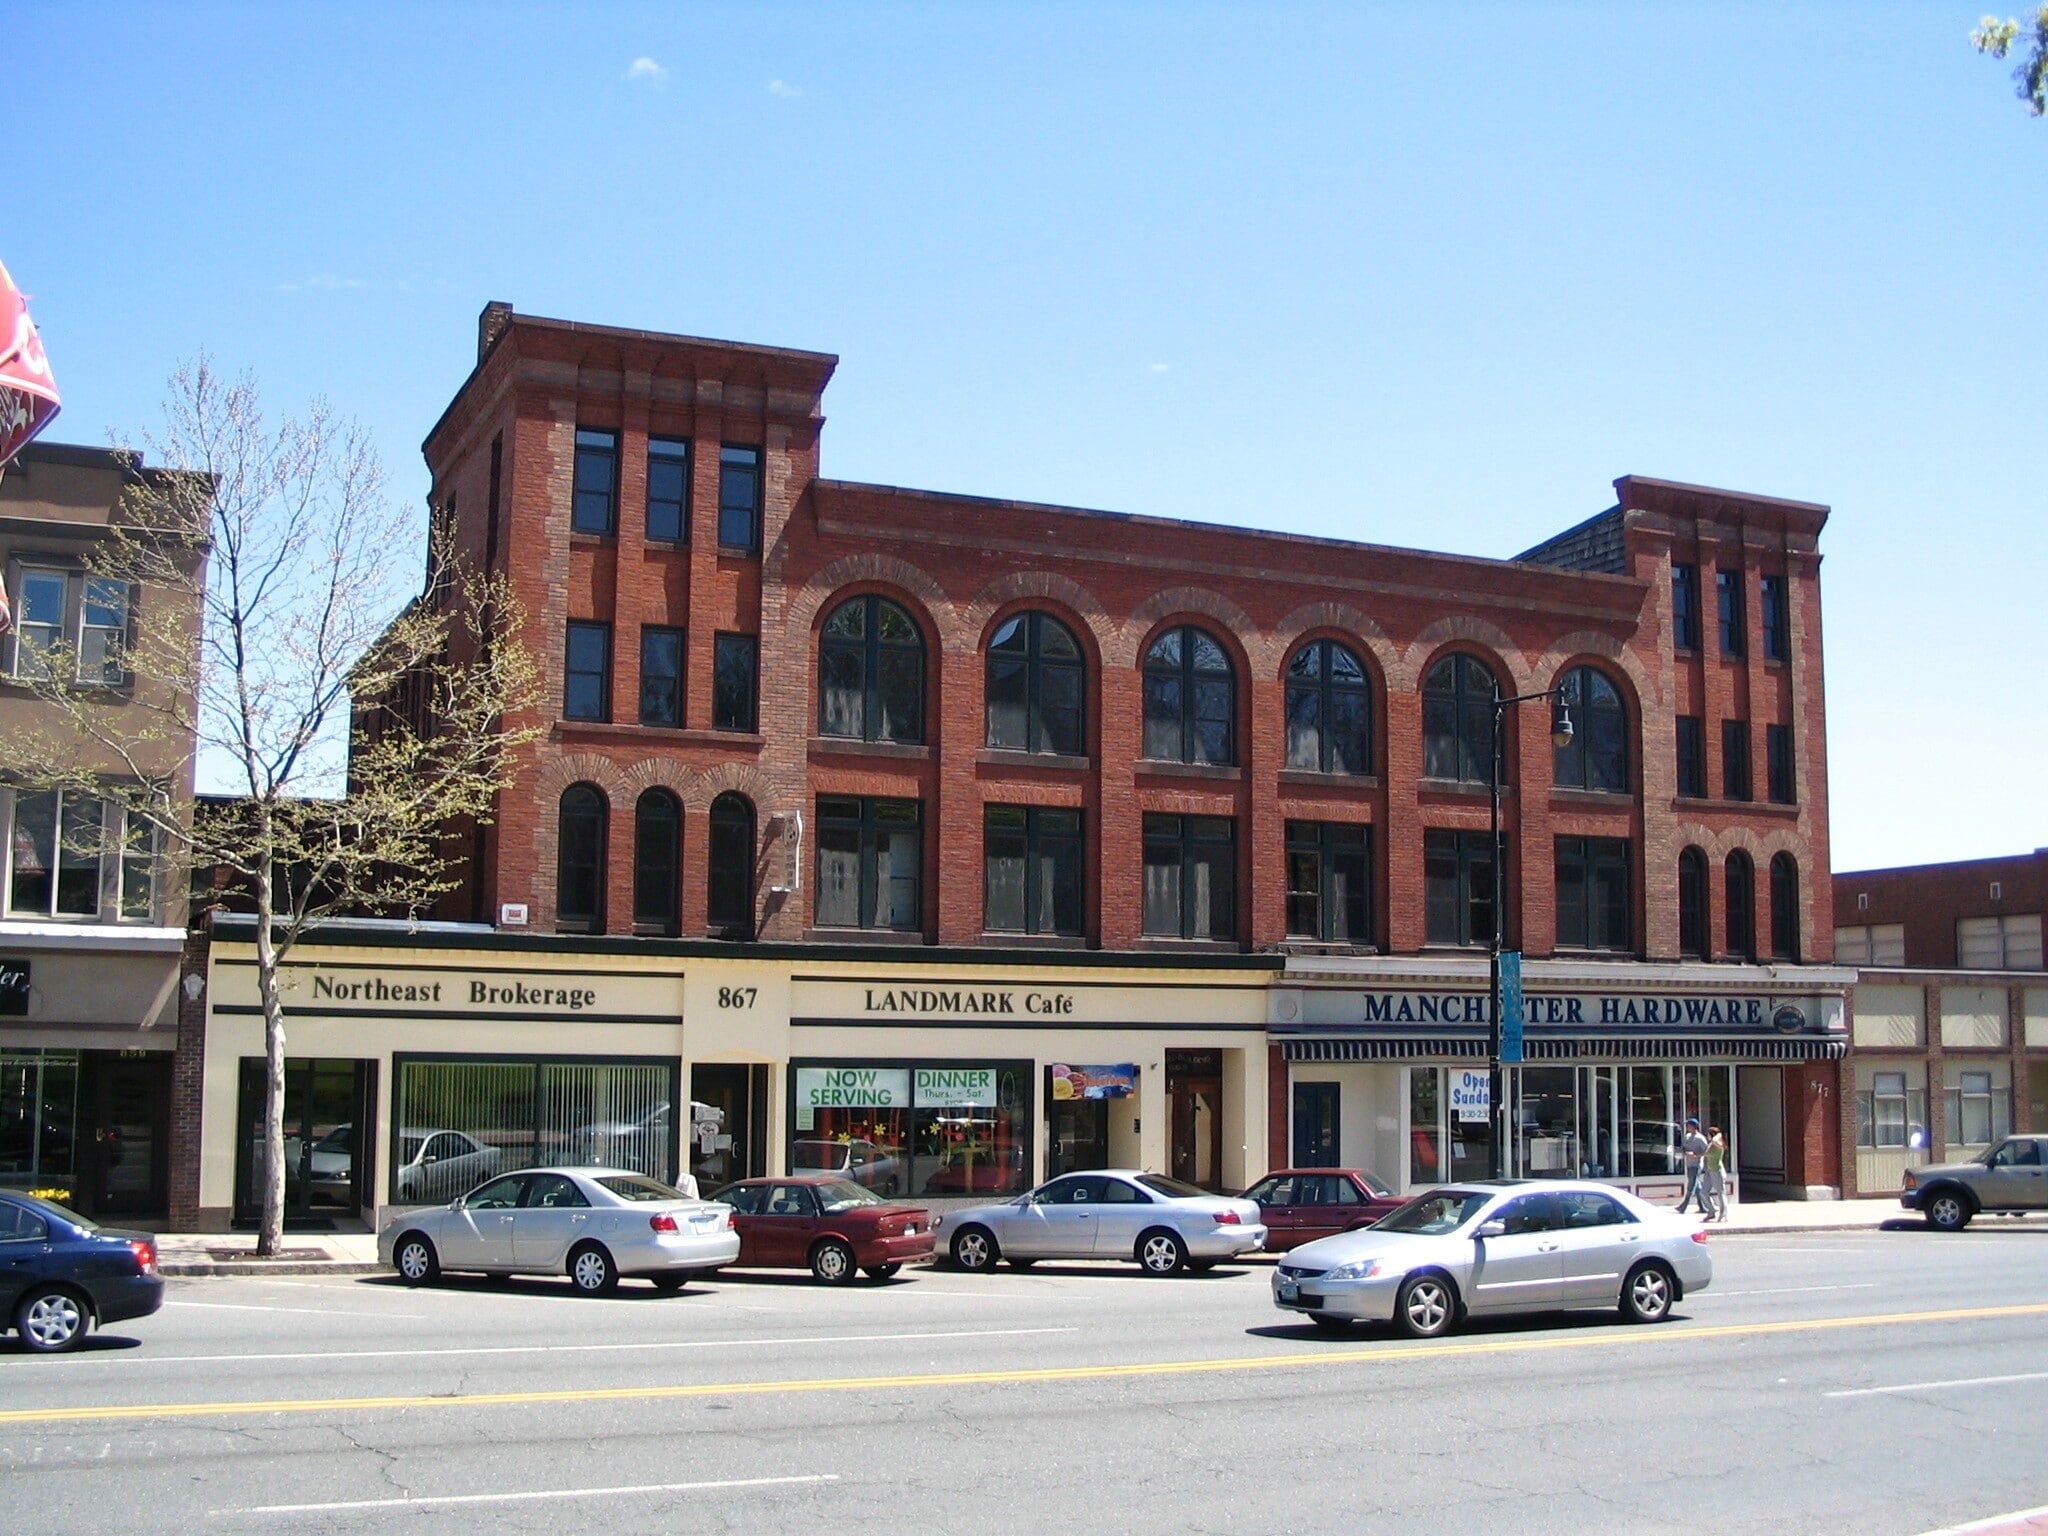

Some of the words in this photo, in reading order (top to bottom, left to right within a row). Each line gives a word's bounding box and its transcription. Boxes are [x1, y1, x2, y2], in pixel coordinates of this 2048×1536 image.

[312, 976, 441, 1002] Northeast
[469, 980, 596, 1009] Brokerage
[718, 987, 758, 1009] 867
[864, 989, 1014, 1014] LANDMARK
[1024, 993, 1074, 1015] Café
[1364, 994, 1584, 1023] MANCHTER
[1600, 998, 1762, 1026] HARDWARE
[825, 1070, 877, 1088] NOW
[917, 1071, 990, 1088] DINNER
[924, 1089, 953, 1098] Thurs.
[966, 1089, 985, 1098] Sat.
[1453, 1088, 1489, 1105] Sunda
[1810, 1080, 1829, 1097] 877
[810, 1089, 893, 1106] SERVING
